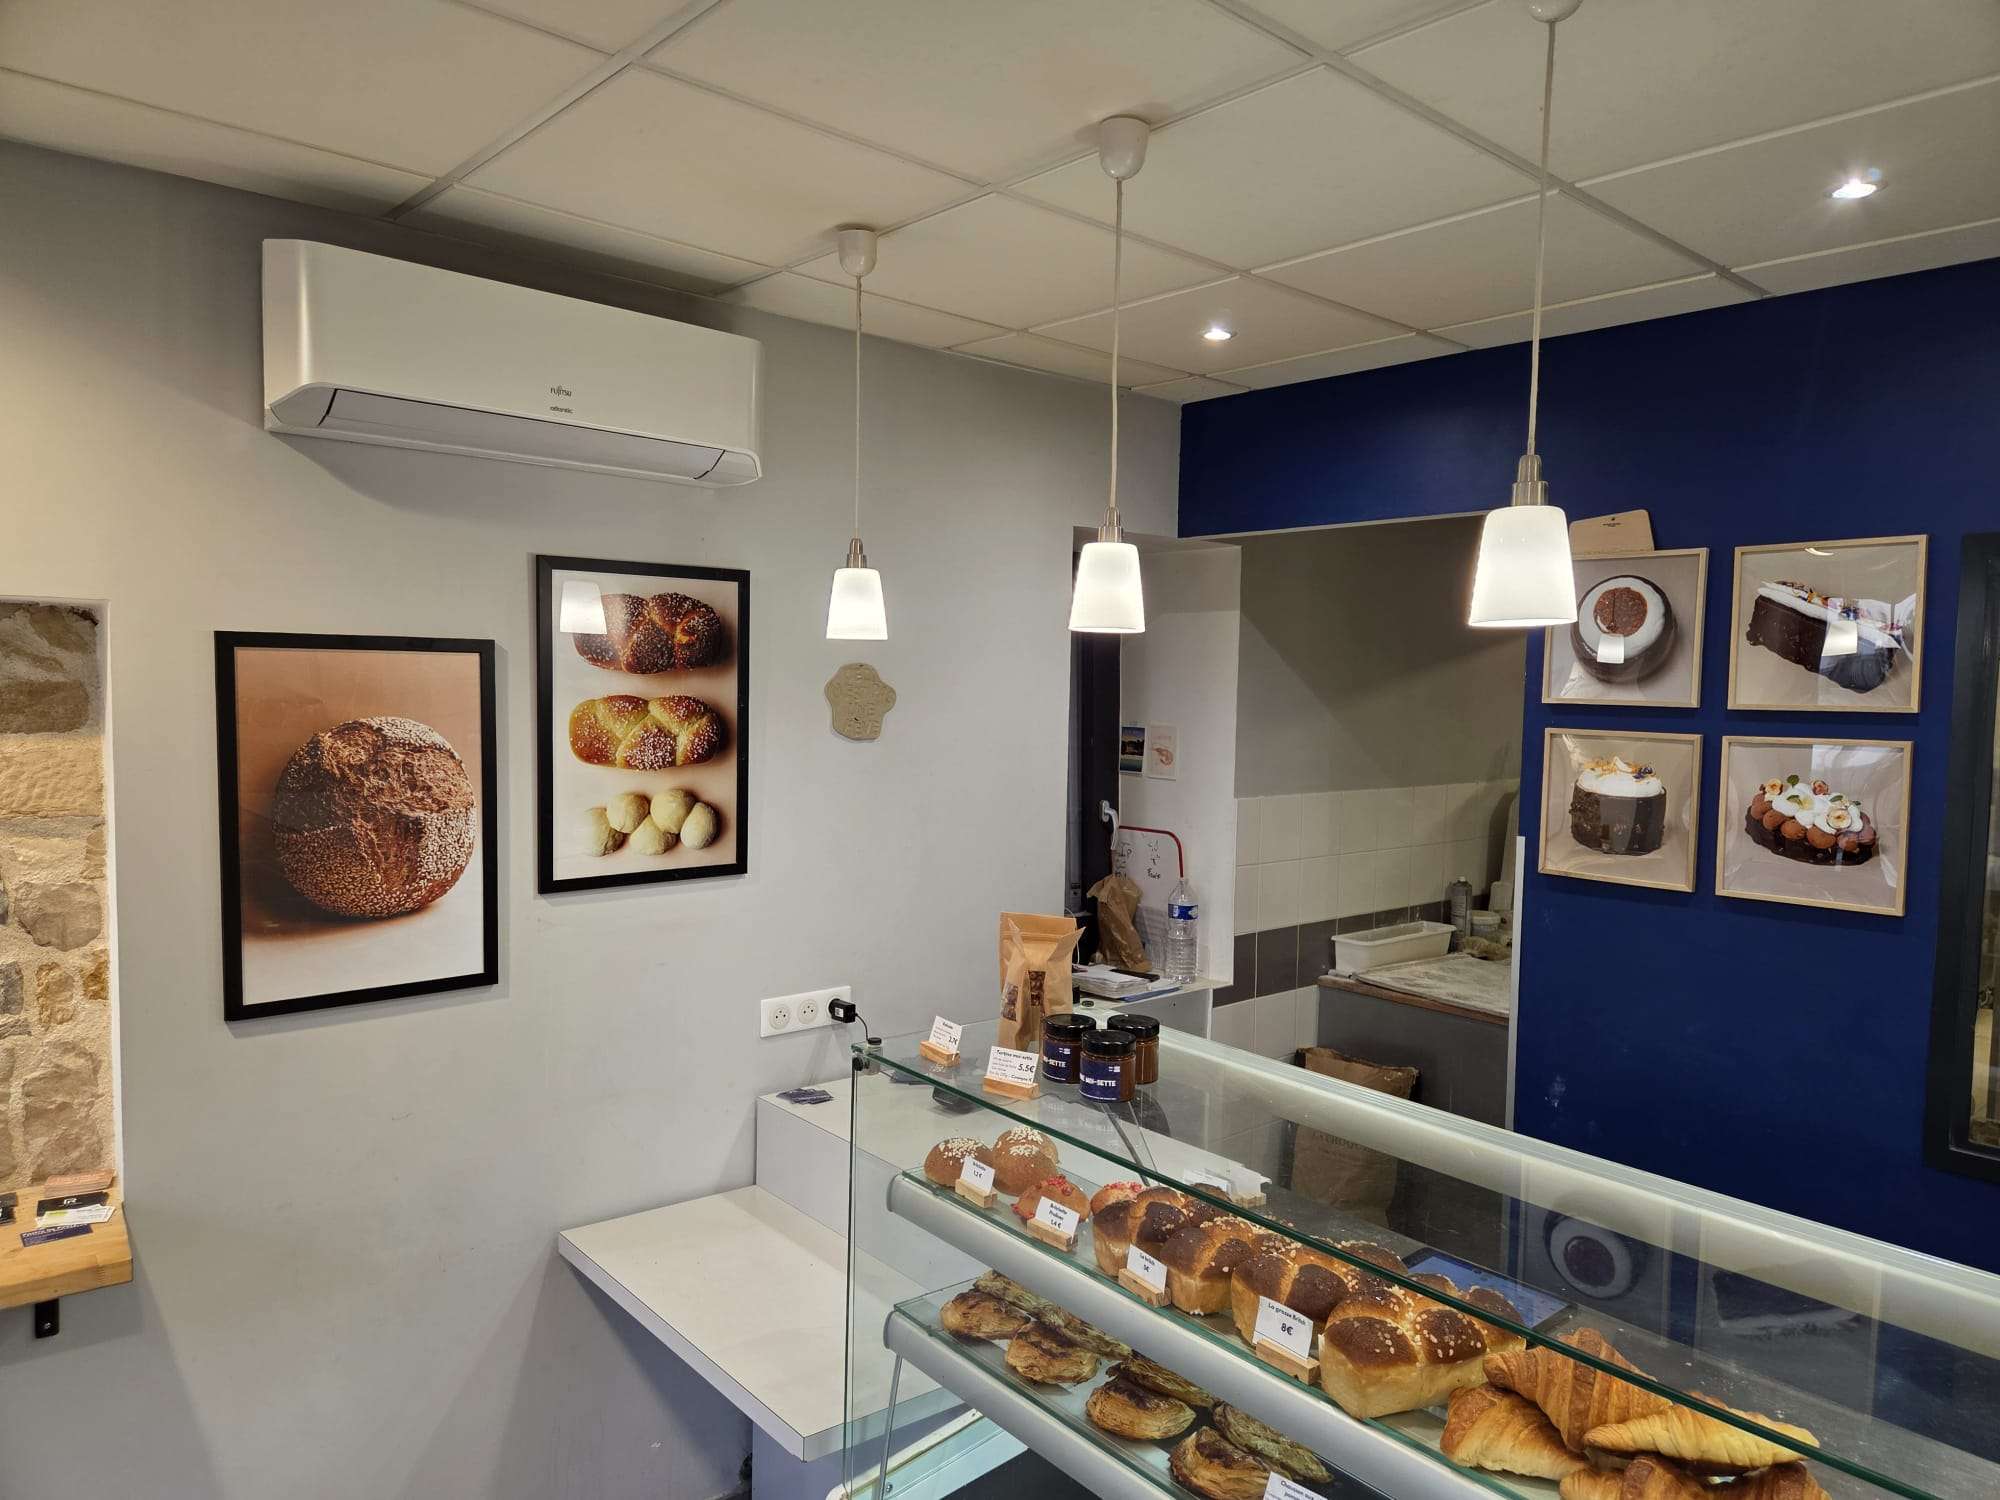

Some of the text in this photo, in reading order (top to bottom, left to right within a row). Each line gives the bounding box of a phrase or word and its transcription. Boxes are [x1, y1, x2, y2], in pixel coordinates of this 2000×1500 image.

[550, 385, 572, 397] FUJITSU
[1267, 1302, 1275, 1310] La
[1275, 1307, 1292, 1318] grosse
[1281, 1322, 1294, 1336] 8€
